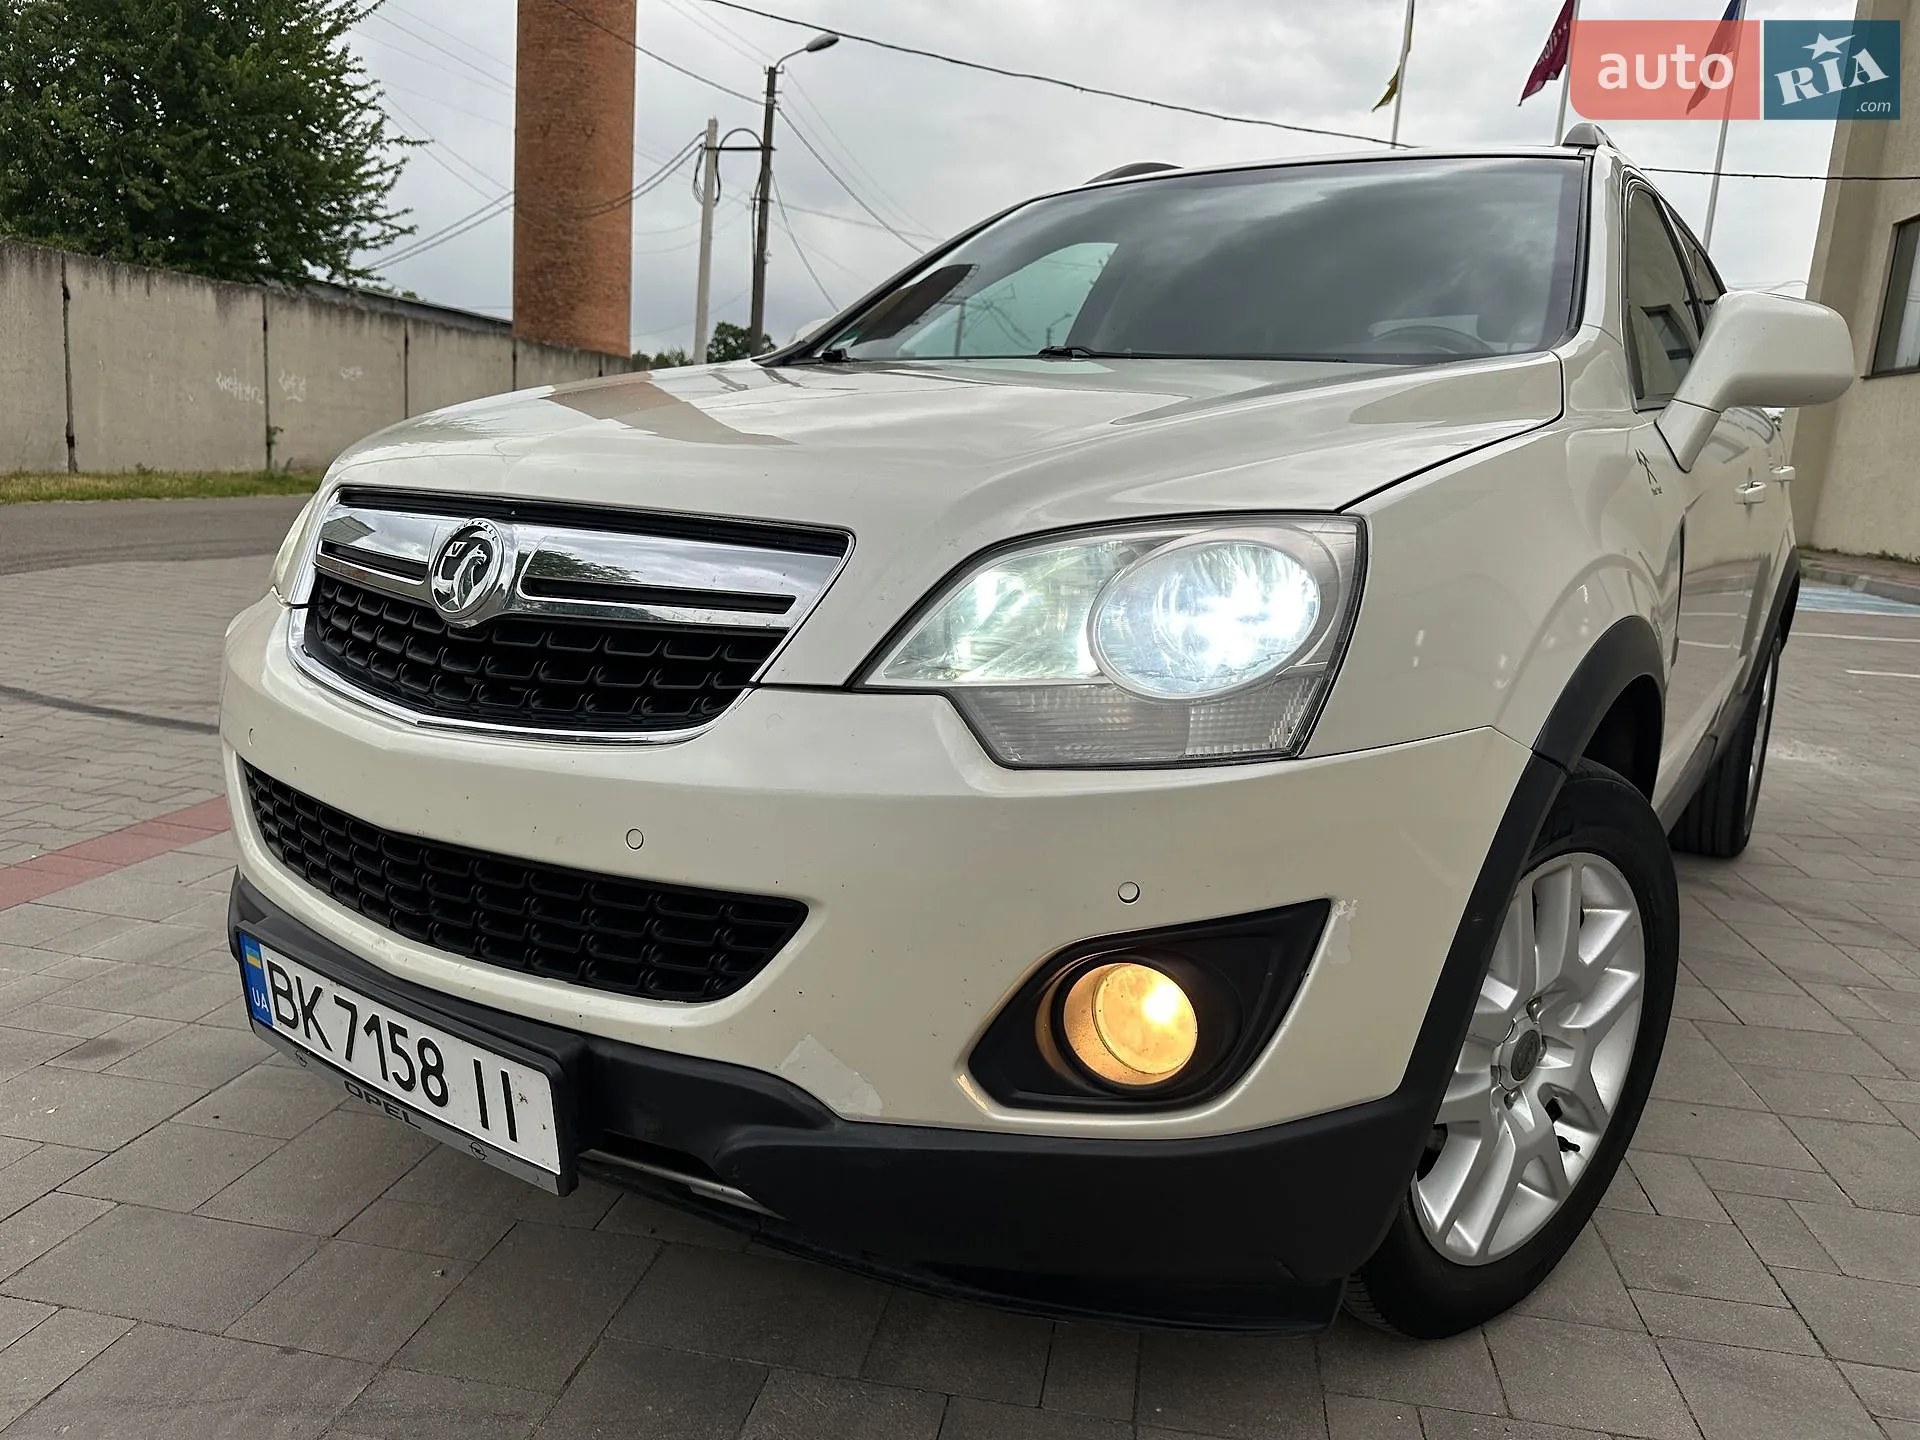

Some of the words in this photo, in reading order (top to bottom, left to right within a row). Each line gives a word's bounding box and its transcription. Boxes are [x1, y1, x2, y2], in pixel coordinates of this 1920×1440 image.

[251, 987, 269, 1012] UA
[266, 959, 333, 1052] BK
[333, 994, 449, 1108] 7158
[473, 1058, 518, 1143] II
[343, 1080, 422, 1130] OPEL
